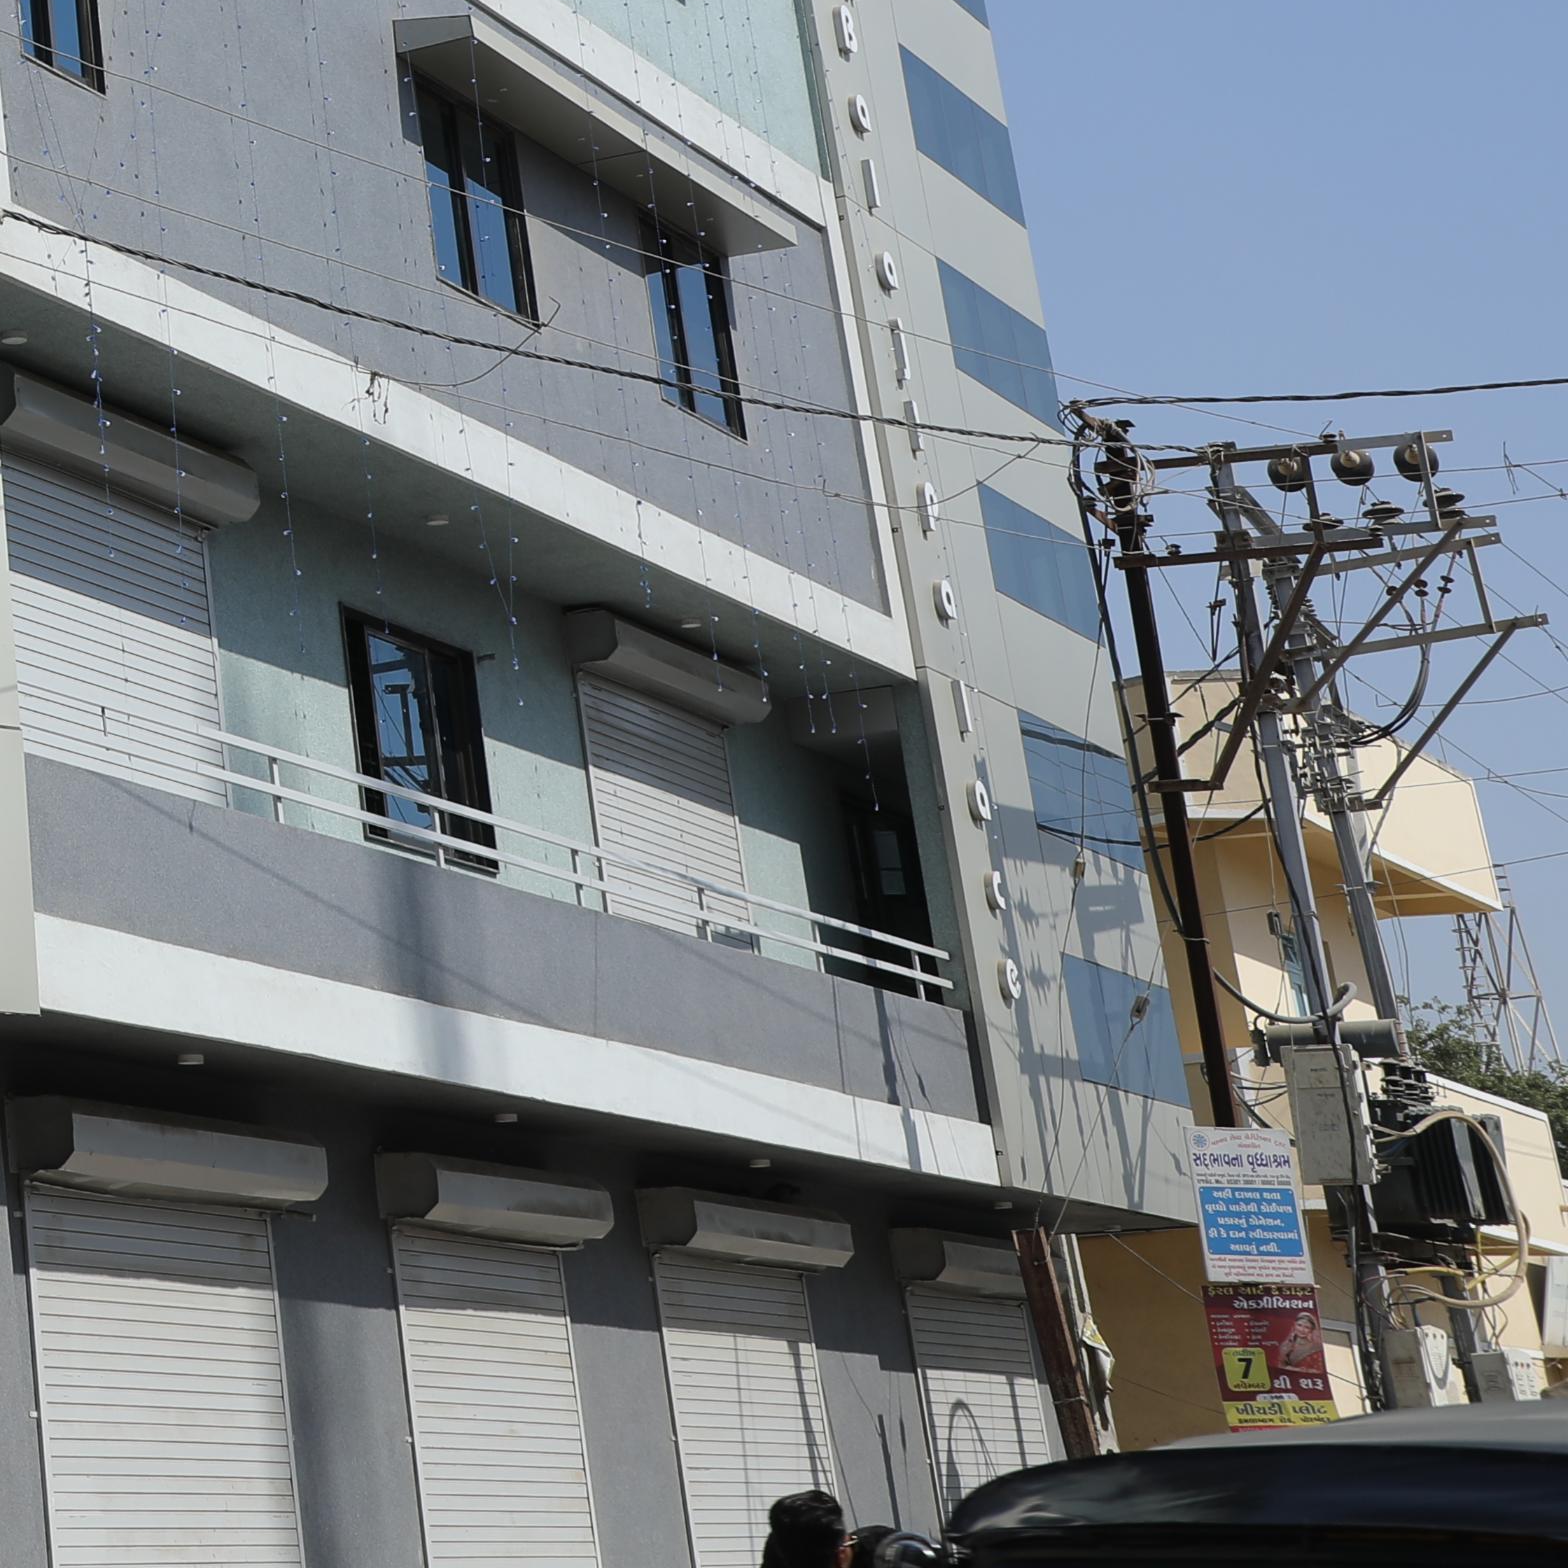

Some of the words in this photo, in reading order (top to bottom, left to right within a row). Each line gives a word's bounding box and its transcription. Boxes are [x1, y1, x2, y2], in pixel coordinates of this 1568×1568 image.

[916, 480, 1022, 1002] Palace
[1237, 1357, 1253, 1379] 7
[1273, 1375, 1292, 1389] થી
